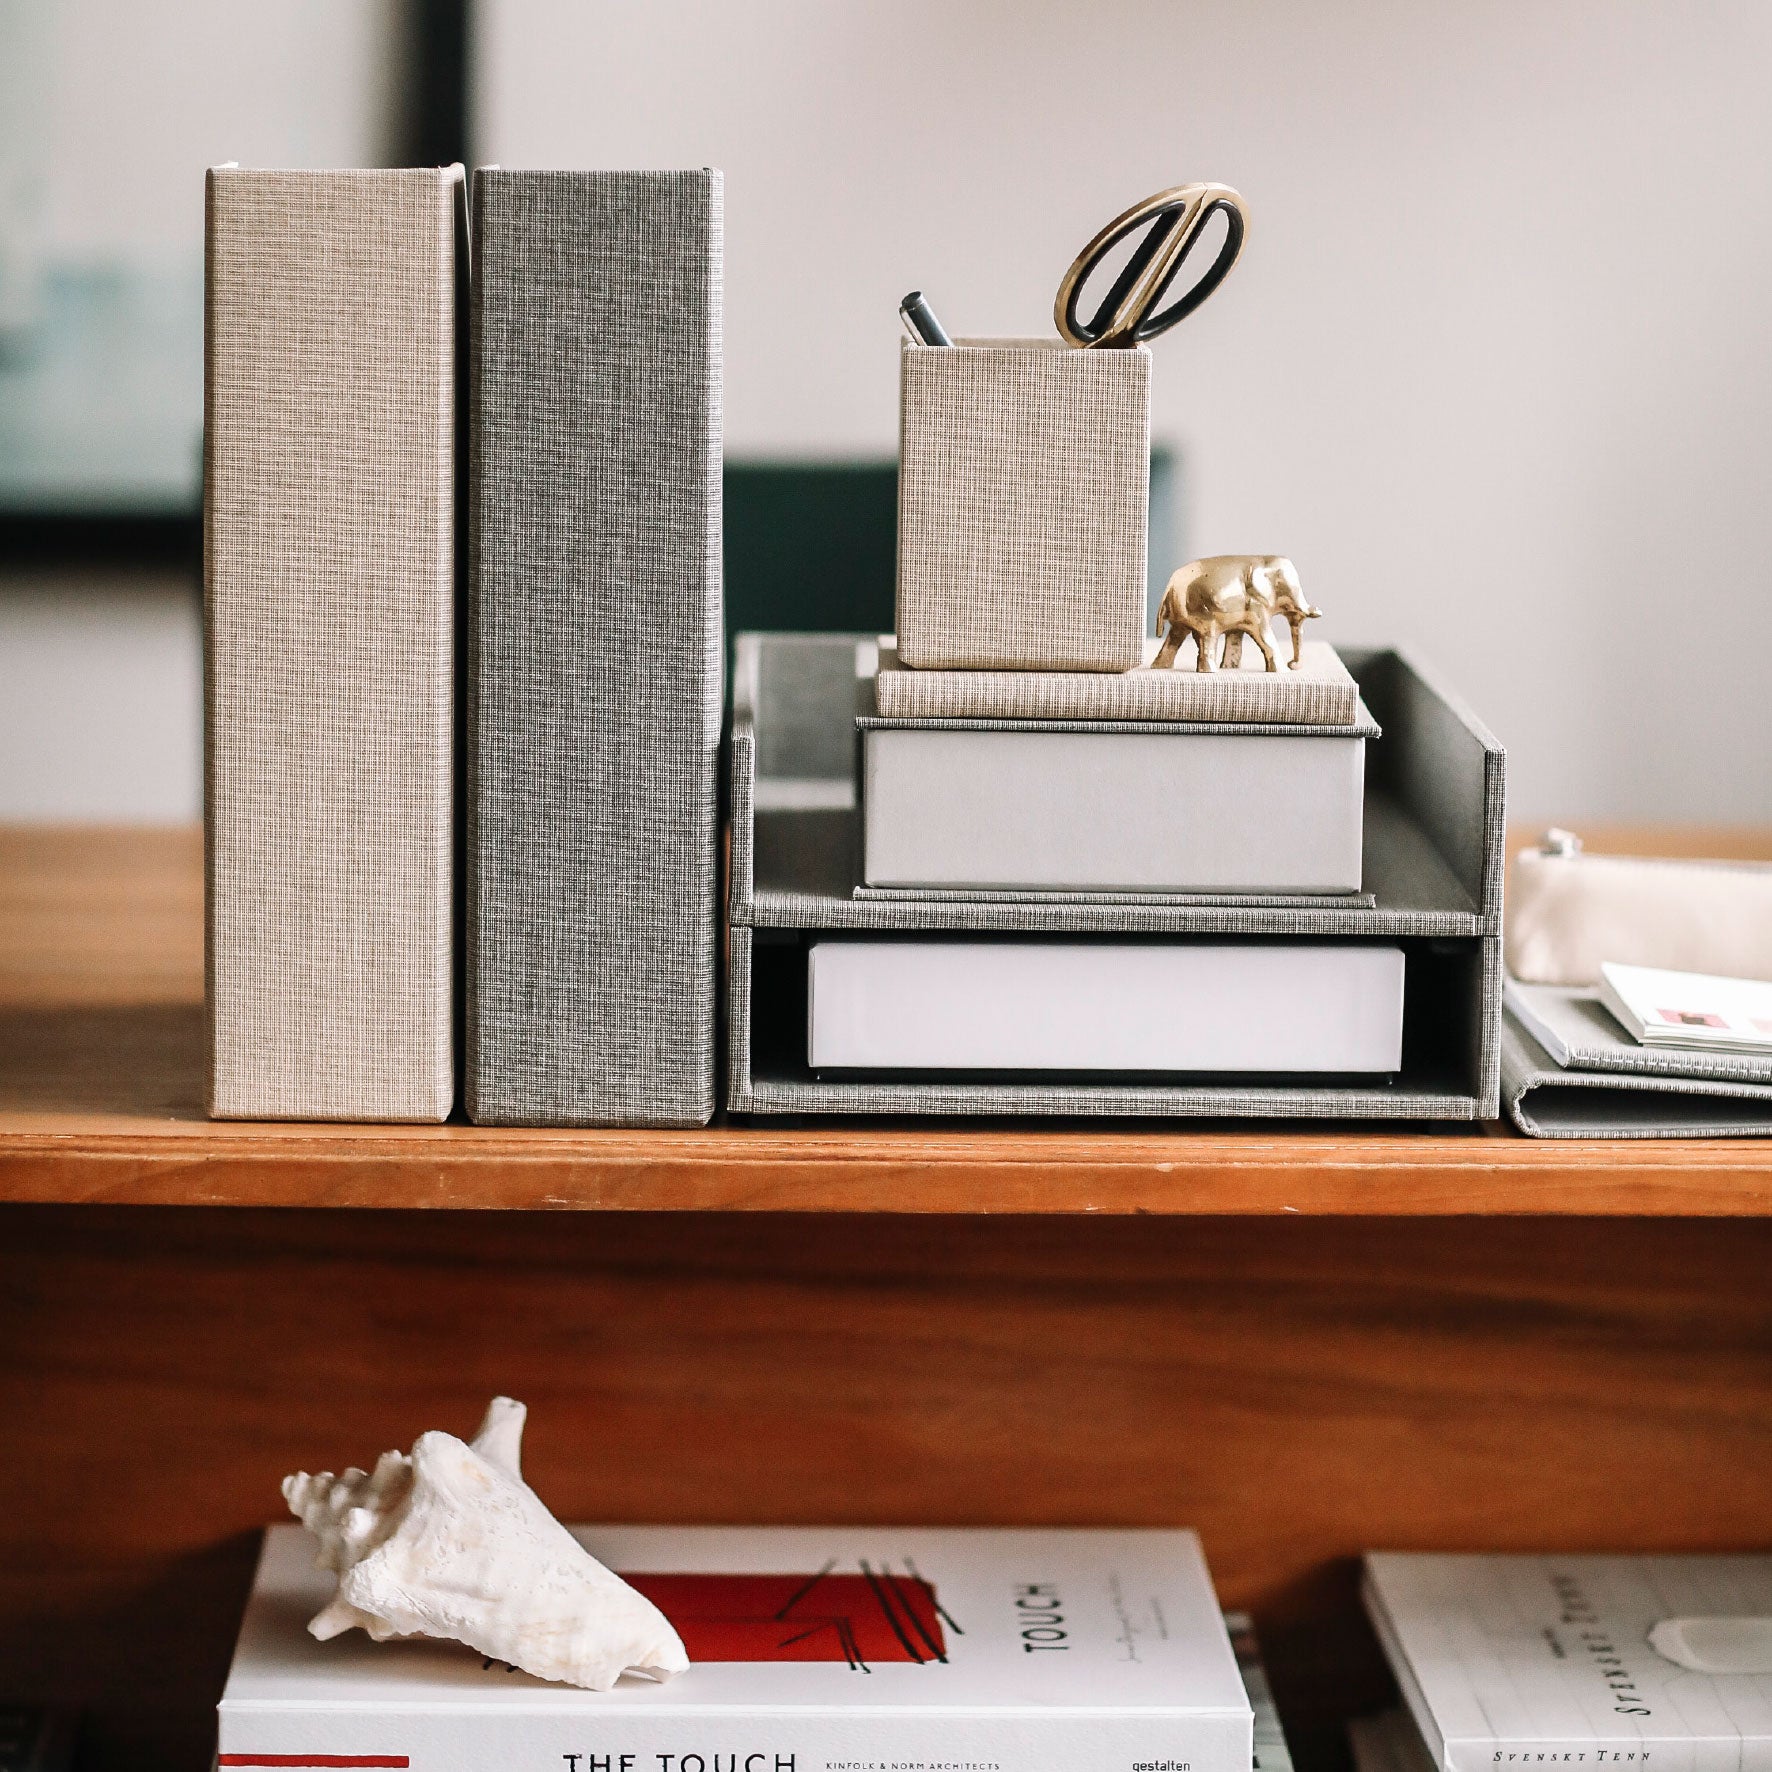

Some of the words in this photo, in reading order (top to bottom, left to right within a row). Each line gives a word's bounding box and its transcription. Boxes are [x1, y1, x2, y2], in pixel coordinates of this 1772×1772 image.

[1015, 1583, 1069, 1653] TOUCH
[1493, 1751, 1586, 1762] SVENSKT
[1597, 1750, 1650, 1762] TENN
[563, 1754, 636, 1772] THE
[656, 1754, 796, 1772] TOUCH
[826, 1762, 876, 1771] KINFOLK
[879, 1762, 887, 1771] &
[891, 1762, 925, 1771] NORM
[929, 1762, 1001, 1771] ARCHITECTS
[1132, 1760, 1191, 1772] gestalten
